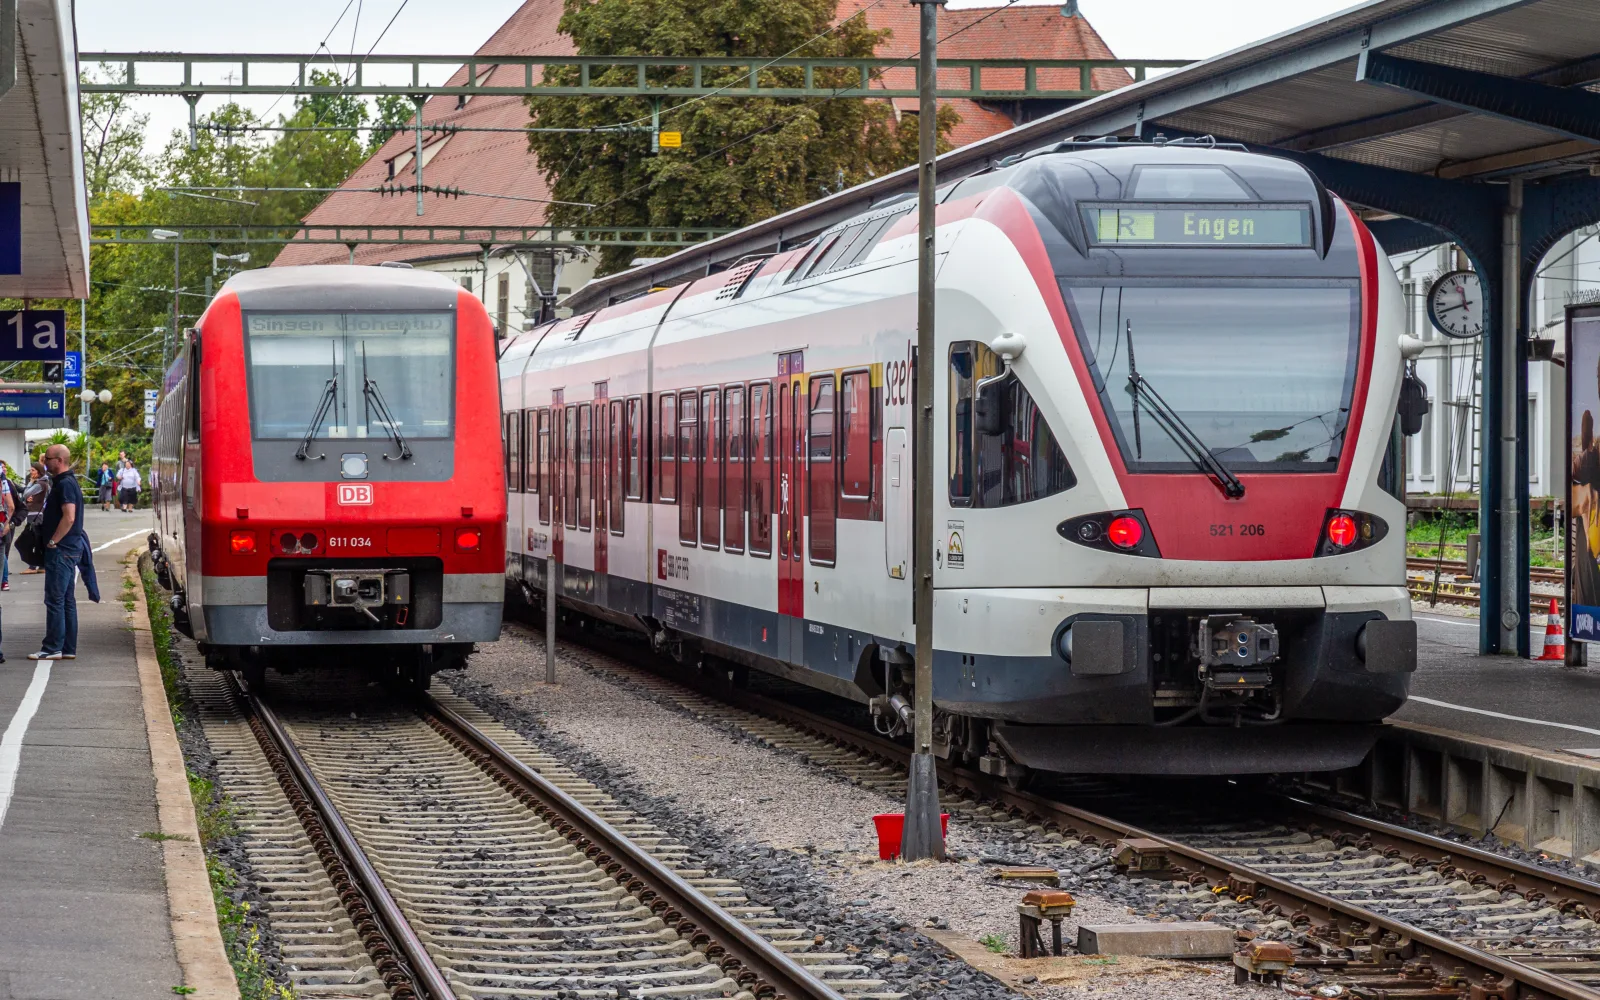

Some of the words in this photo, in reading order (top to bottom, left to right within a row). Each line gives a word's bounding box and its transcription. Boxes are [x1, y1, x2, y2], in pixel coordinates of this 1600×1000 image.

[1119, 215, 1136, 236] R
[1184, 212, 1255, 240] Engen
[7, 311, 58, 349] 1a
[252, 317, 324, 332] Singen
[47, 399, 59, 410] 1a
[342, 487, 369, 502] DB
[1209, 524, 1233, 536] 521
[1240, 524, 1265, 536] 206
[329, 537, 347, 547] 611
[350, 537, 371, 547] 034
